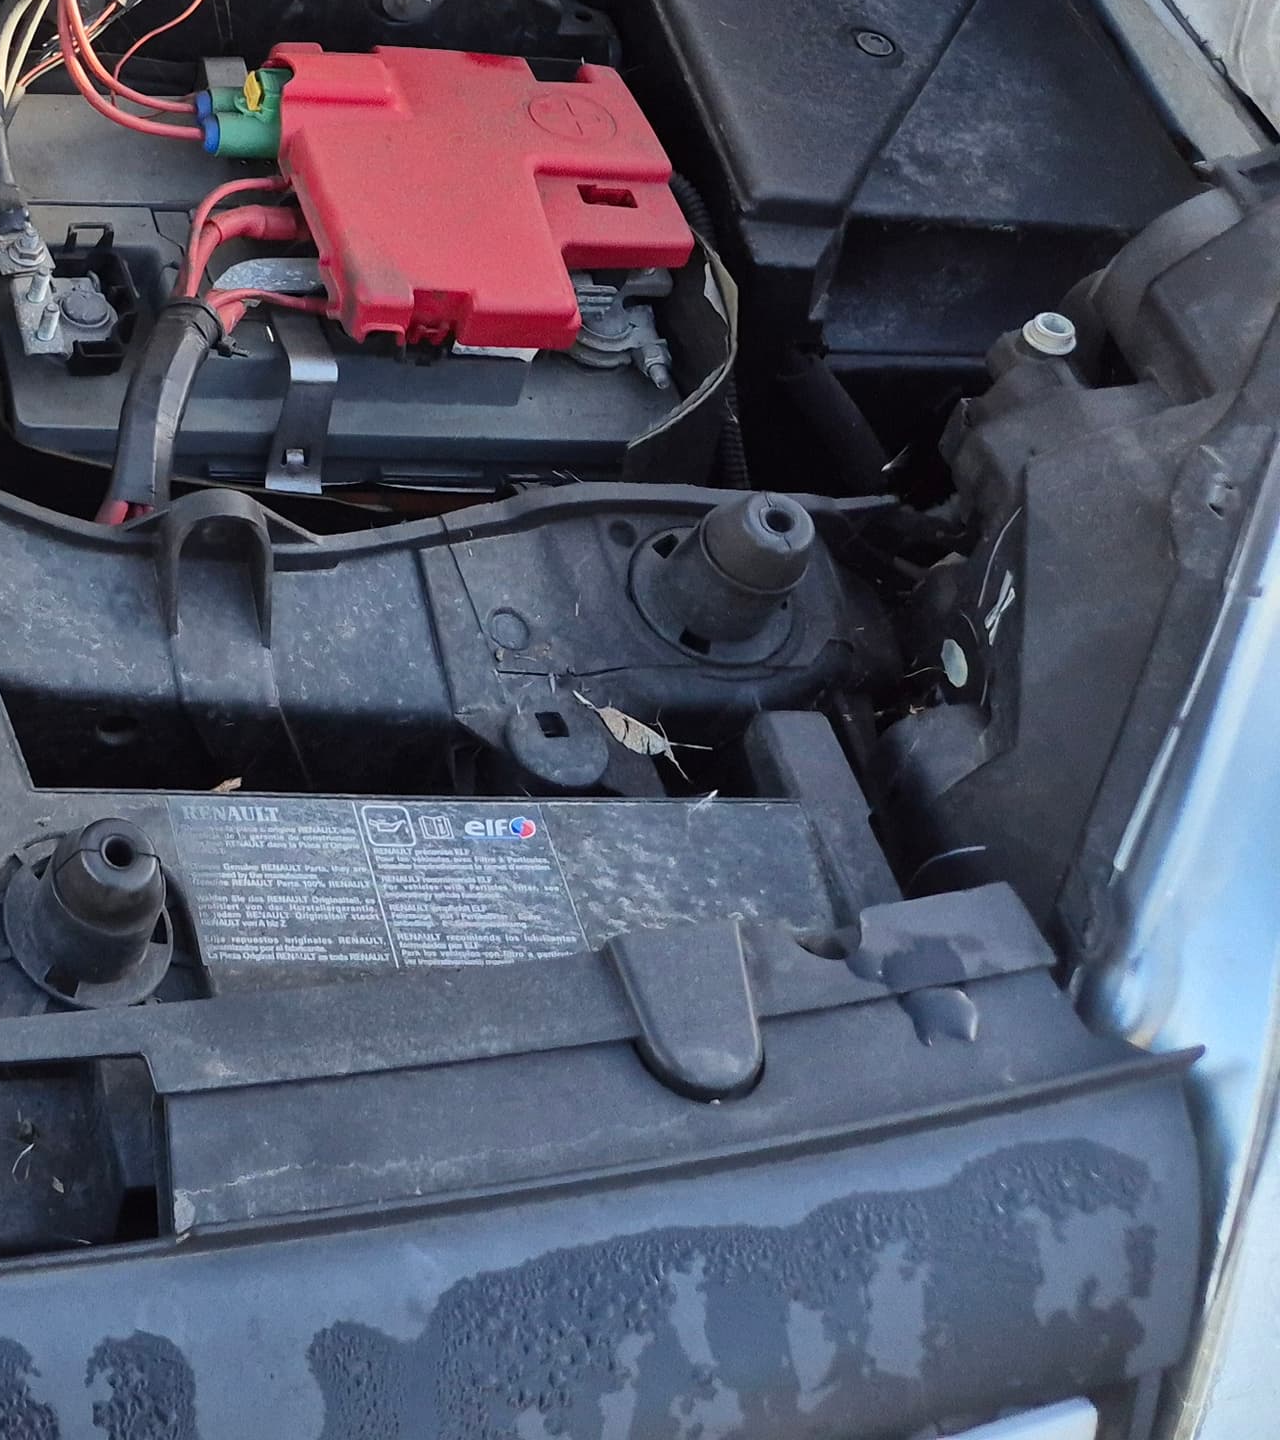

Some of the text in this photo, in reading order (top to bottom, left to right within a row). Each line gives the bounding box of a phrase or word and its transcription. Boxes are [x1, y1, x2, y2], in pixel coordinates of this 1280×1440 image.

[182, 806, 278, 821] RENAULT
[464, 818, 508, 836] elf
[374, 847, 413, 855] RENAULT
[261, 863, 301, 872] RENAULT
[381, 875, 421, 884] RENAULT
[231, 879, 274, 888] RENAULT
[302, 880, 327, 889] 100%
[328, 880, 372, 890] RENAULT
[267, 895, 309, 904] RENAULT
[388, 904, 429, 913] RENAULT
[245, 911, 289, 920] RENAULT
[201, 919, 240, 927] RENAULT
[280, 920, 289, 928] Z
[231, 936, 280, 945] repuestos
[283, 935, 334, 946] originales
[337, 936, 387, 946] RENAULT,
[396, 933, 441, 941] RENAULT
[275, 952, 317, 961] RENAULT
[348, 952, 391, 961] RENAULT
